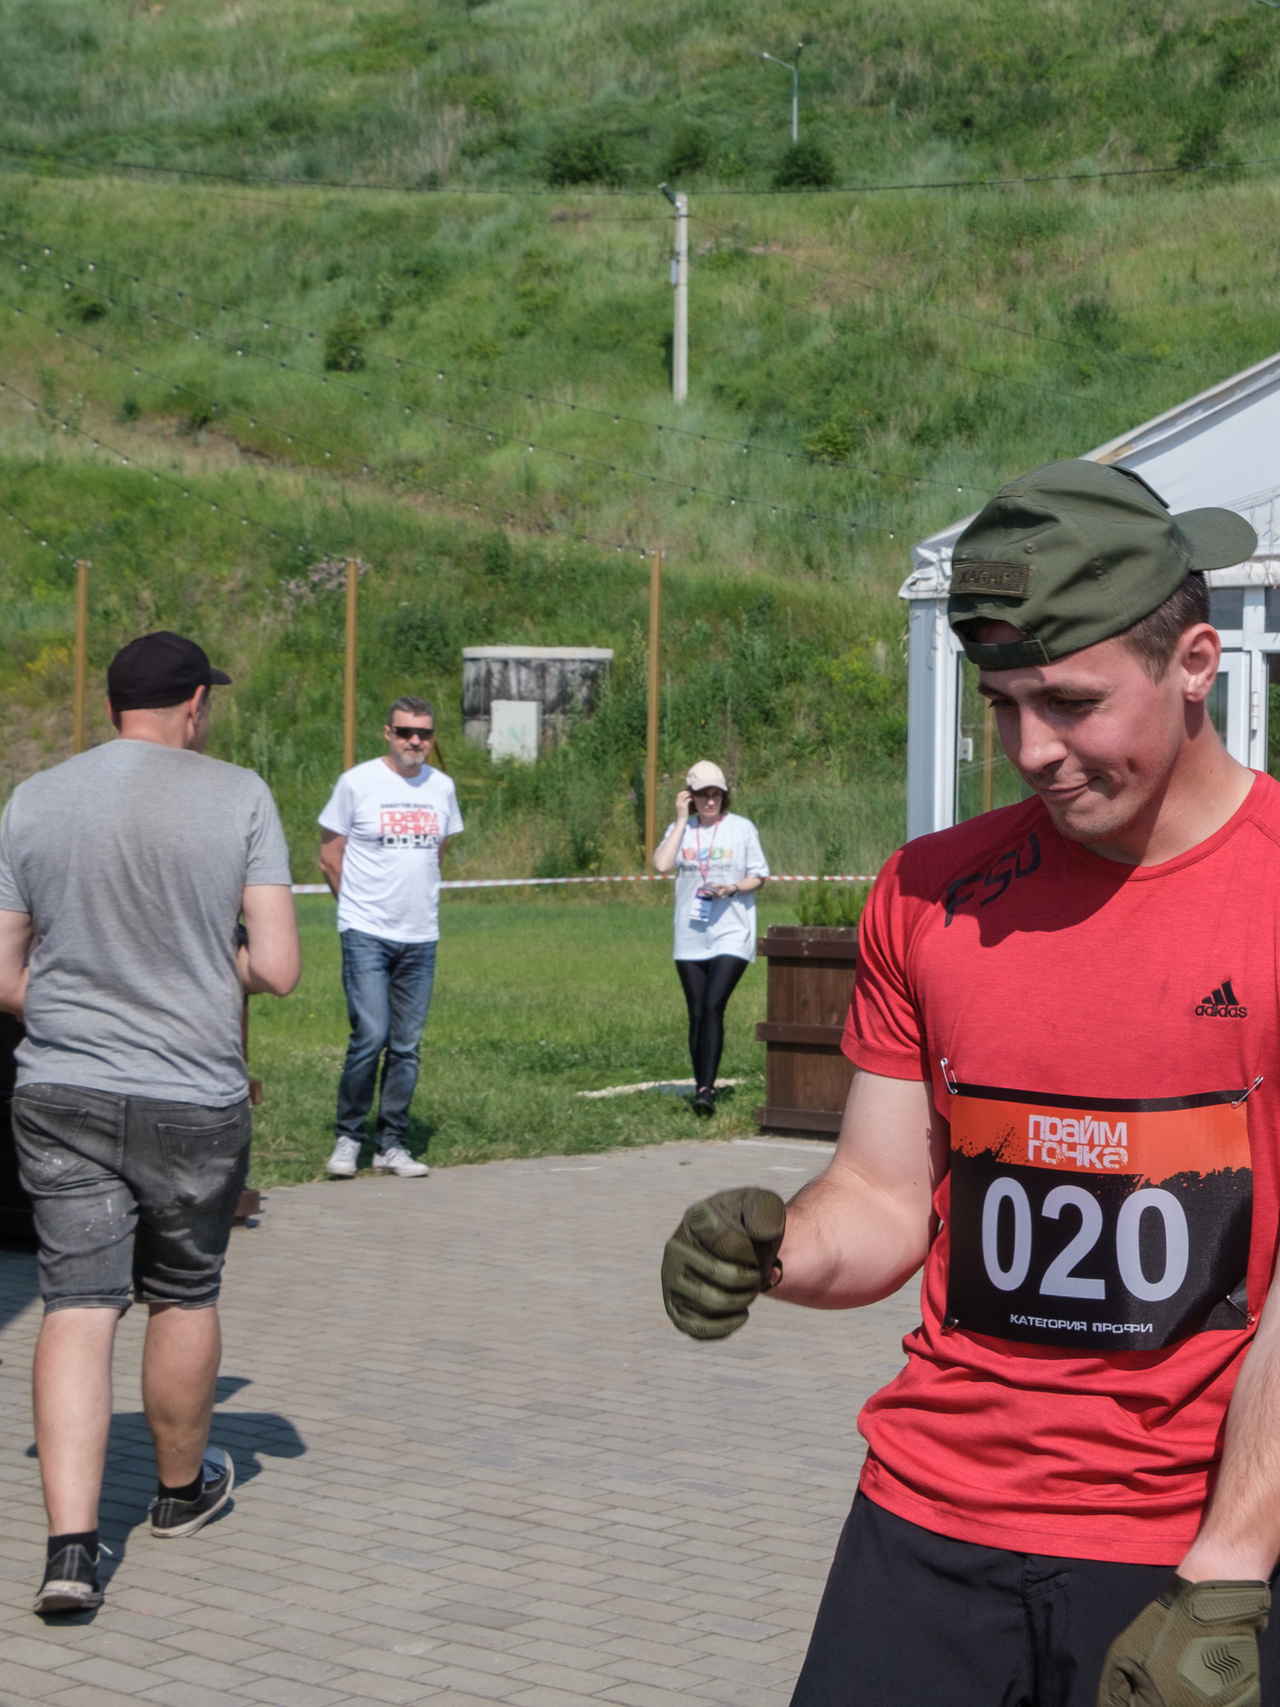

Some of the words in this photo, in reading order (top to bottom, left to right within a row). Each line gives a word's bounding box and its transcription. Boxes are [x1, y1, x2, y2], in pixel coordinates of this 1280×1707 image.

[1195, 1003, 1248, 1018] adidas
[982, 1176, 1190, 1302] 020
[1010, 1313, 1087, 1332] КАТЕГОРИЯ
[1092, 1322, 1154, 1334] ПРОФИ
